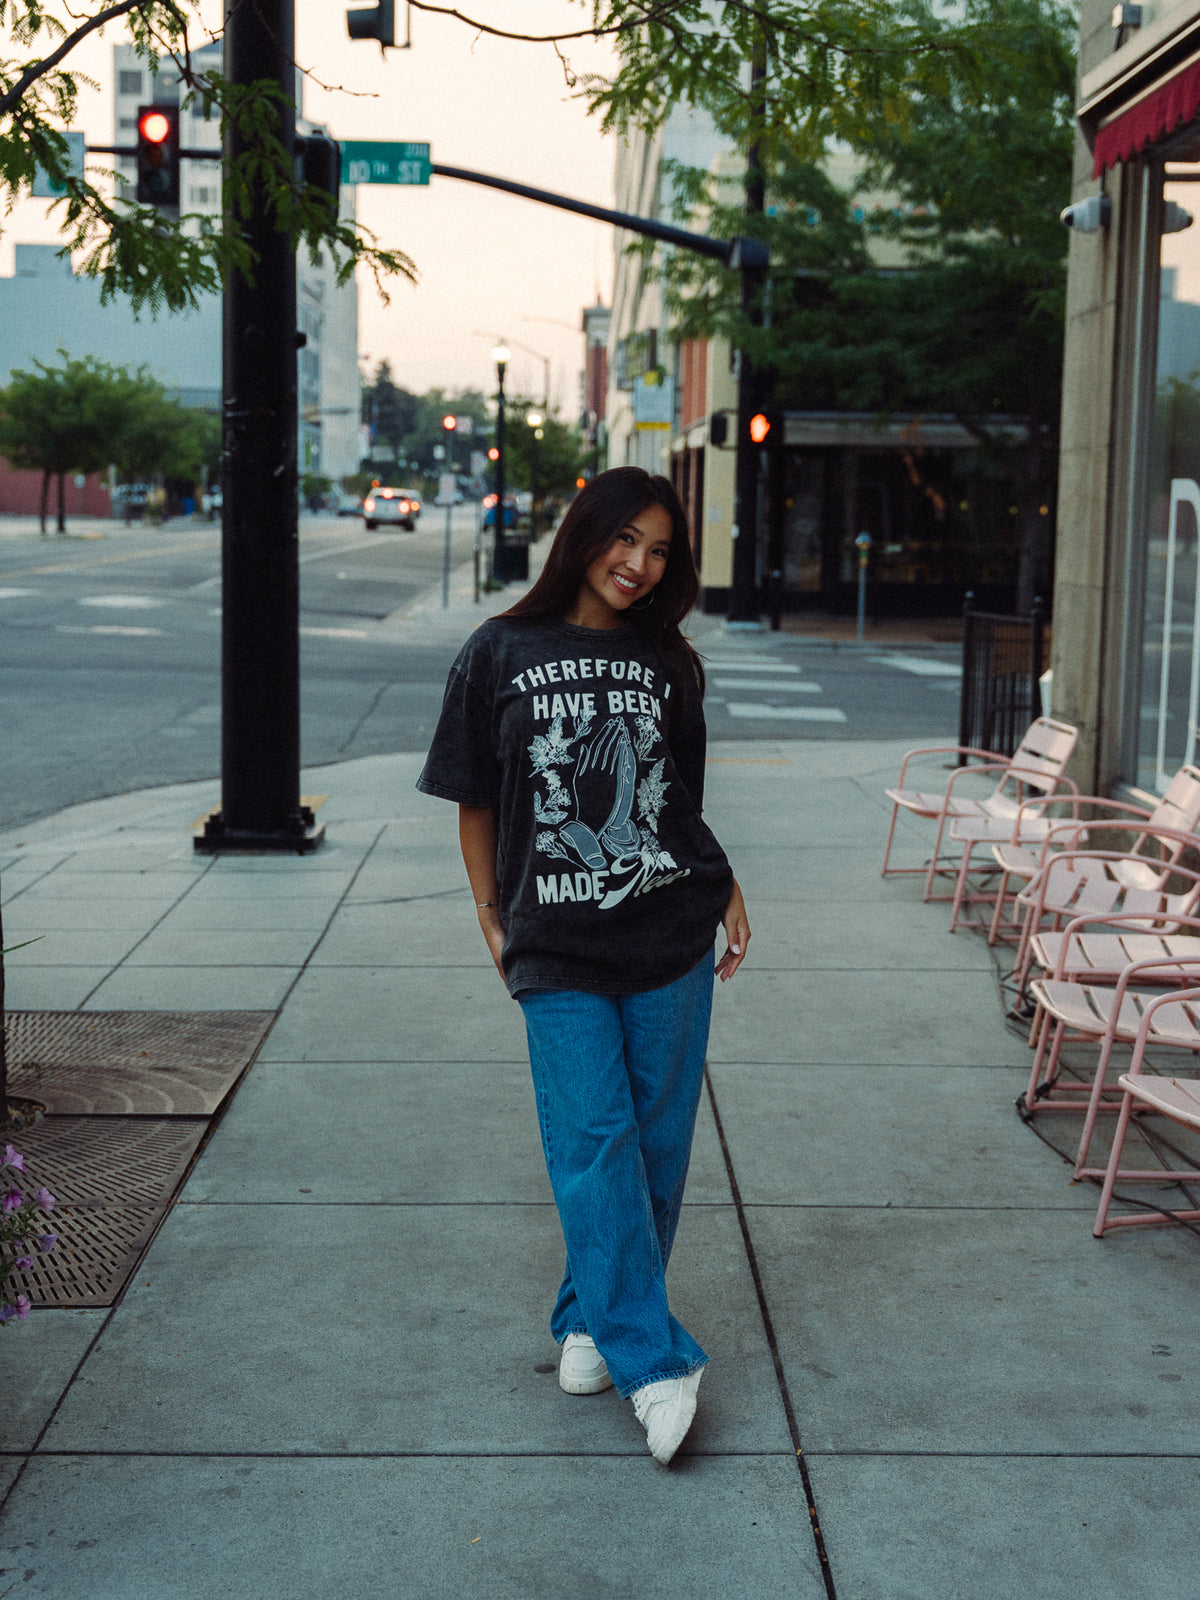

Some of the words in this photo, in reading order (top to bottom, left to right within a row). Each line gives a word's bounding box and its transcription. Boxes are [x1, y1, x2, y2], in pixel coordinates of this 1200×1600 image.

[398, 160, 422, 184] ST
[511, 658, 655, 692] THEREFORE
[664, 683, 672, 699] I
[533, 693, 597, 720] HAVE
[607, 690, 662, 721] BEEN
[536, 870, 610, 905] MADE
